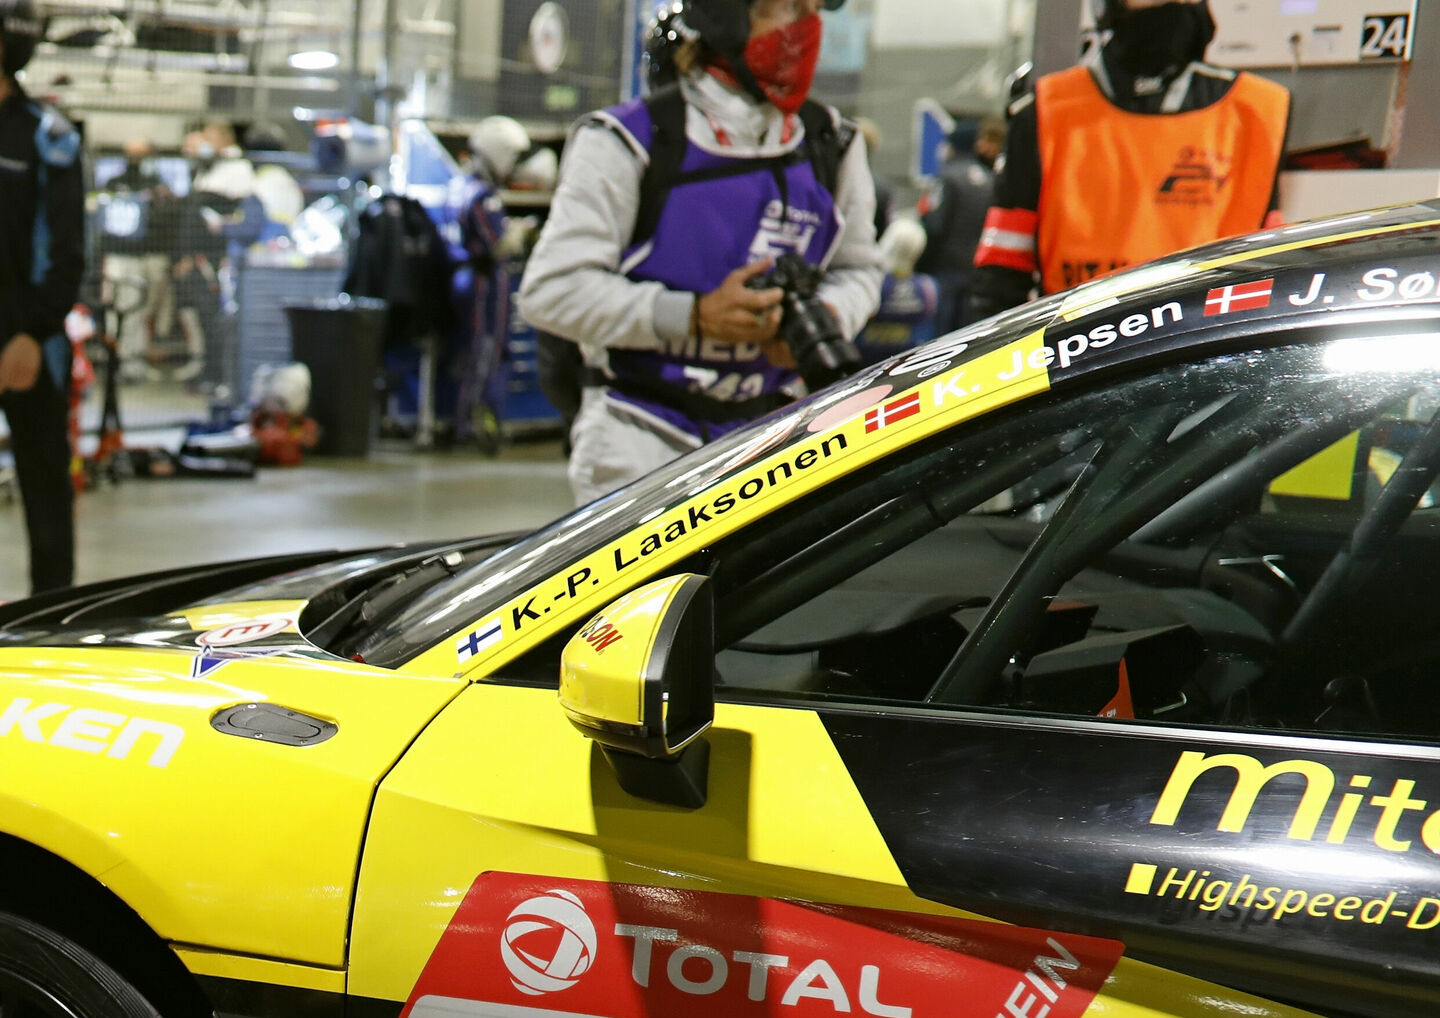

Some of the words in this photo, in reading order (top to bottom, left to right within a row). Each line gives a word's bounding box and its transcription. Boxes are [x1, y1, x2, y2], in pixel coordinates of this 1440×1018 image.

[1361, 17, 1406, 57] 24
[1288, 272, 1335, 306] J.
[1357, 267, 1440, 301] Sø
[933, 371, 980, 408] K.
[997, 300, 1184, 382] Jepsen
[513, 567, 599, 631] K.-P.
[614, 433, 848, 572] Laaksonen
